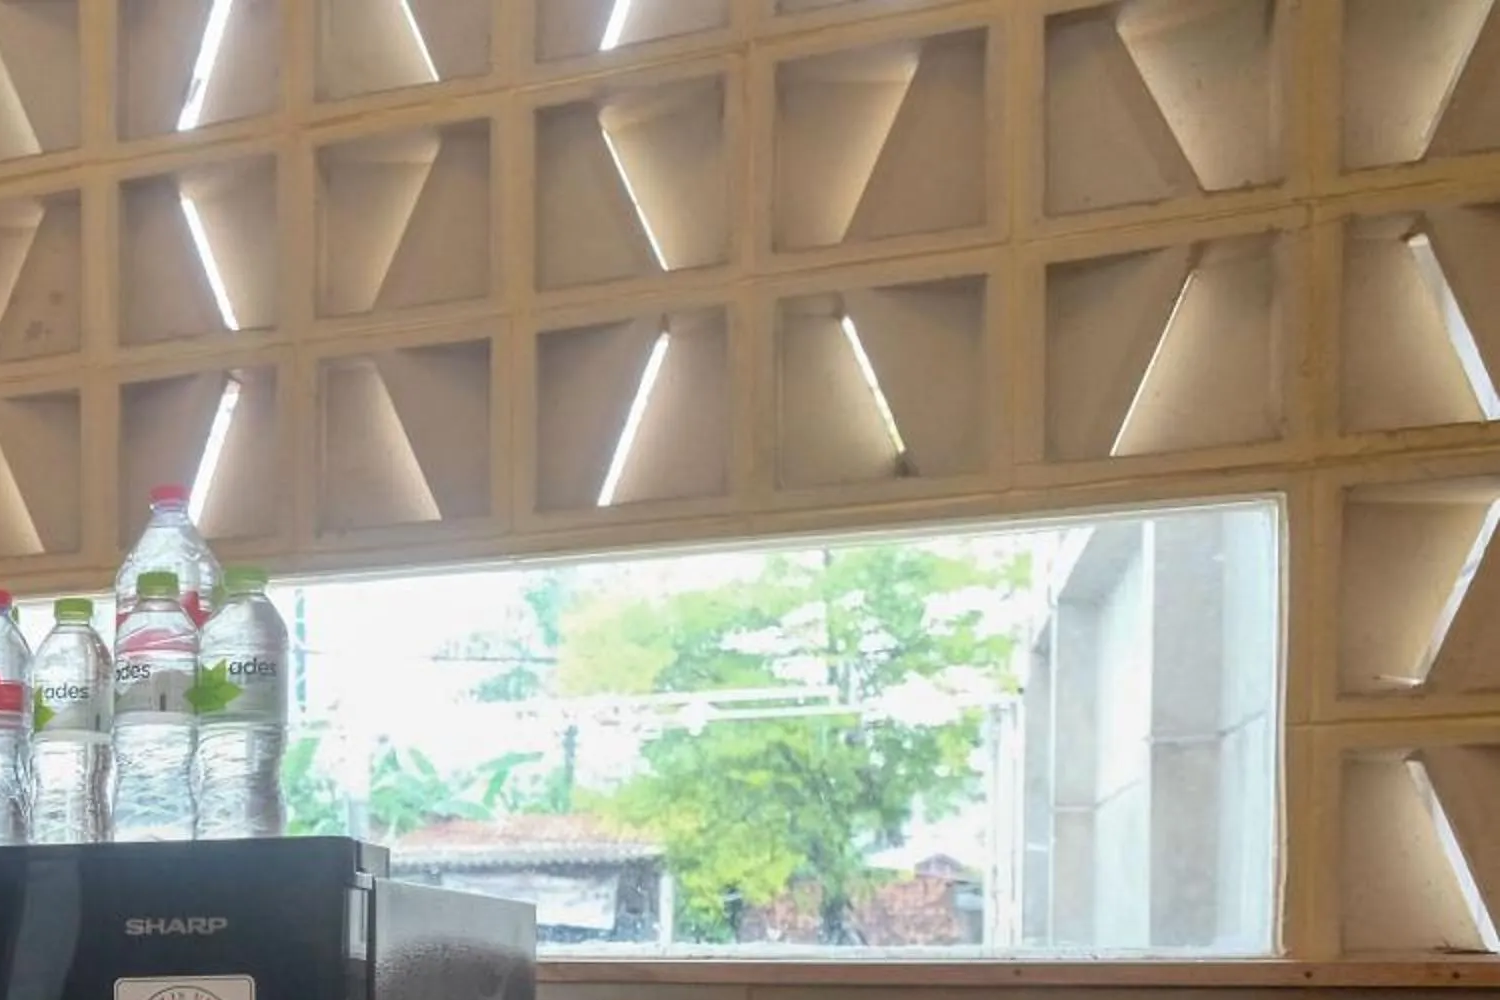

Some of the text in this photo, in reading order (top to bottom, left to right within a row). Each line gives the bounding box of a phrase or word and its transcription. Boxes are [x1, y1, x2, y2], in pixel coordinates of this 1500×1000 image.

[229, 656, 277, 677] ades
[44, 682, 90, 700] ades
[124, 917, 229, 936] SHARP
